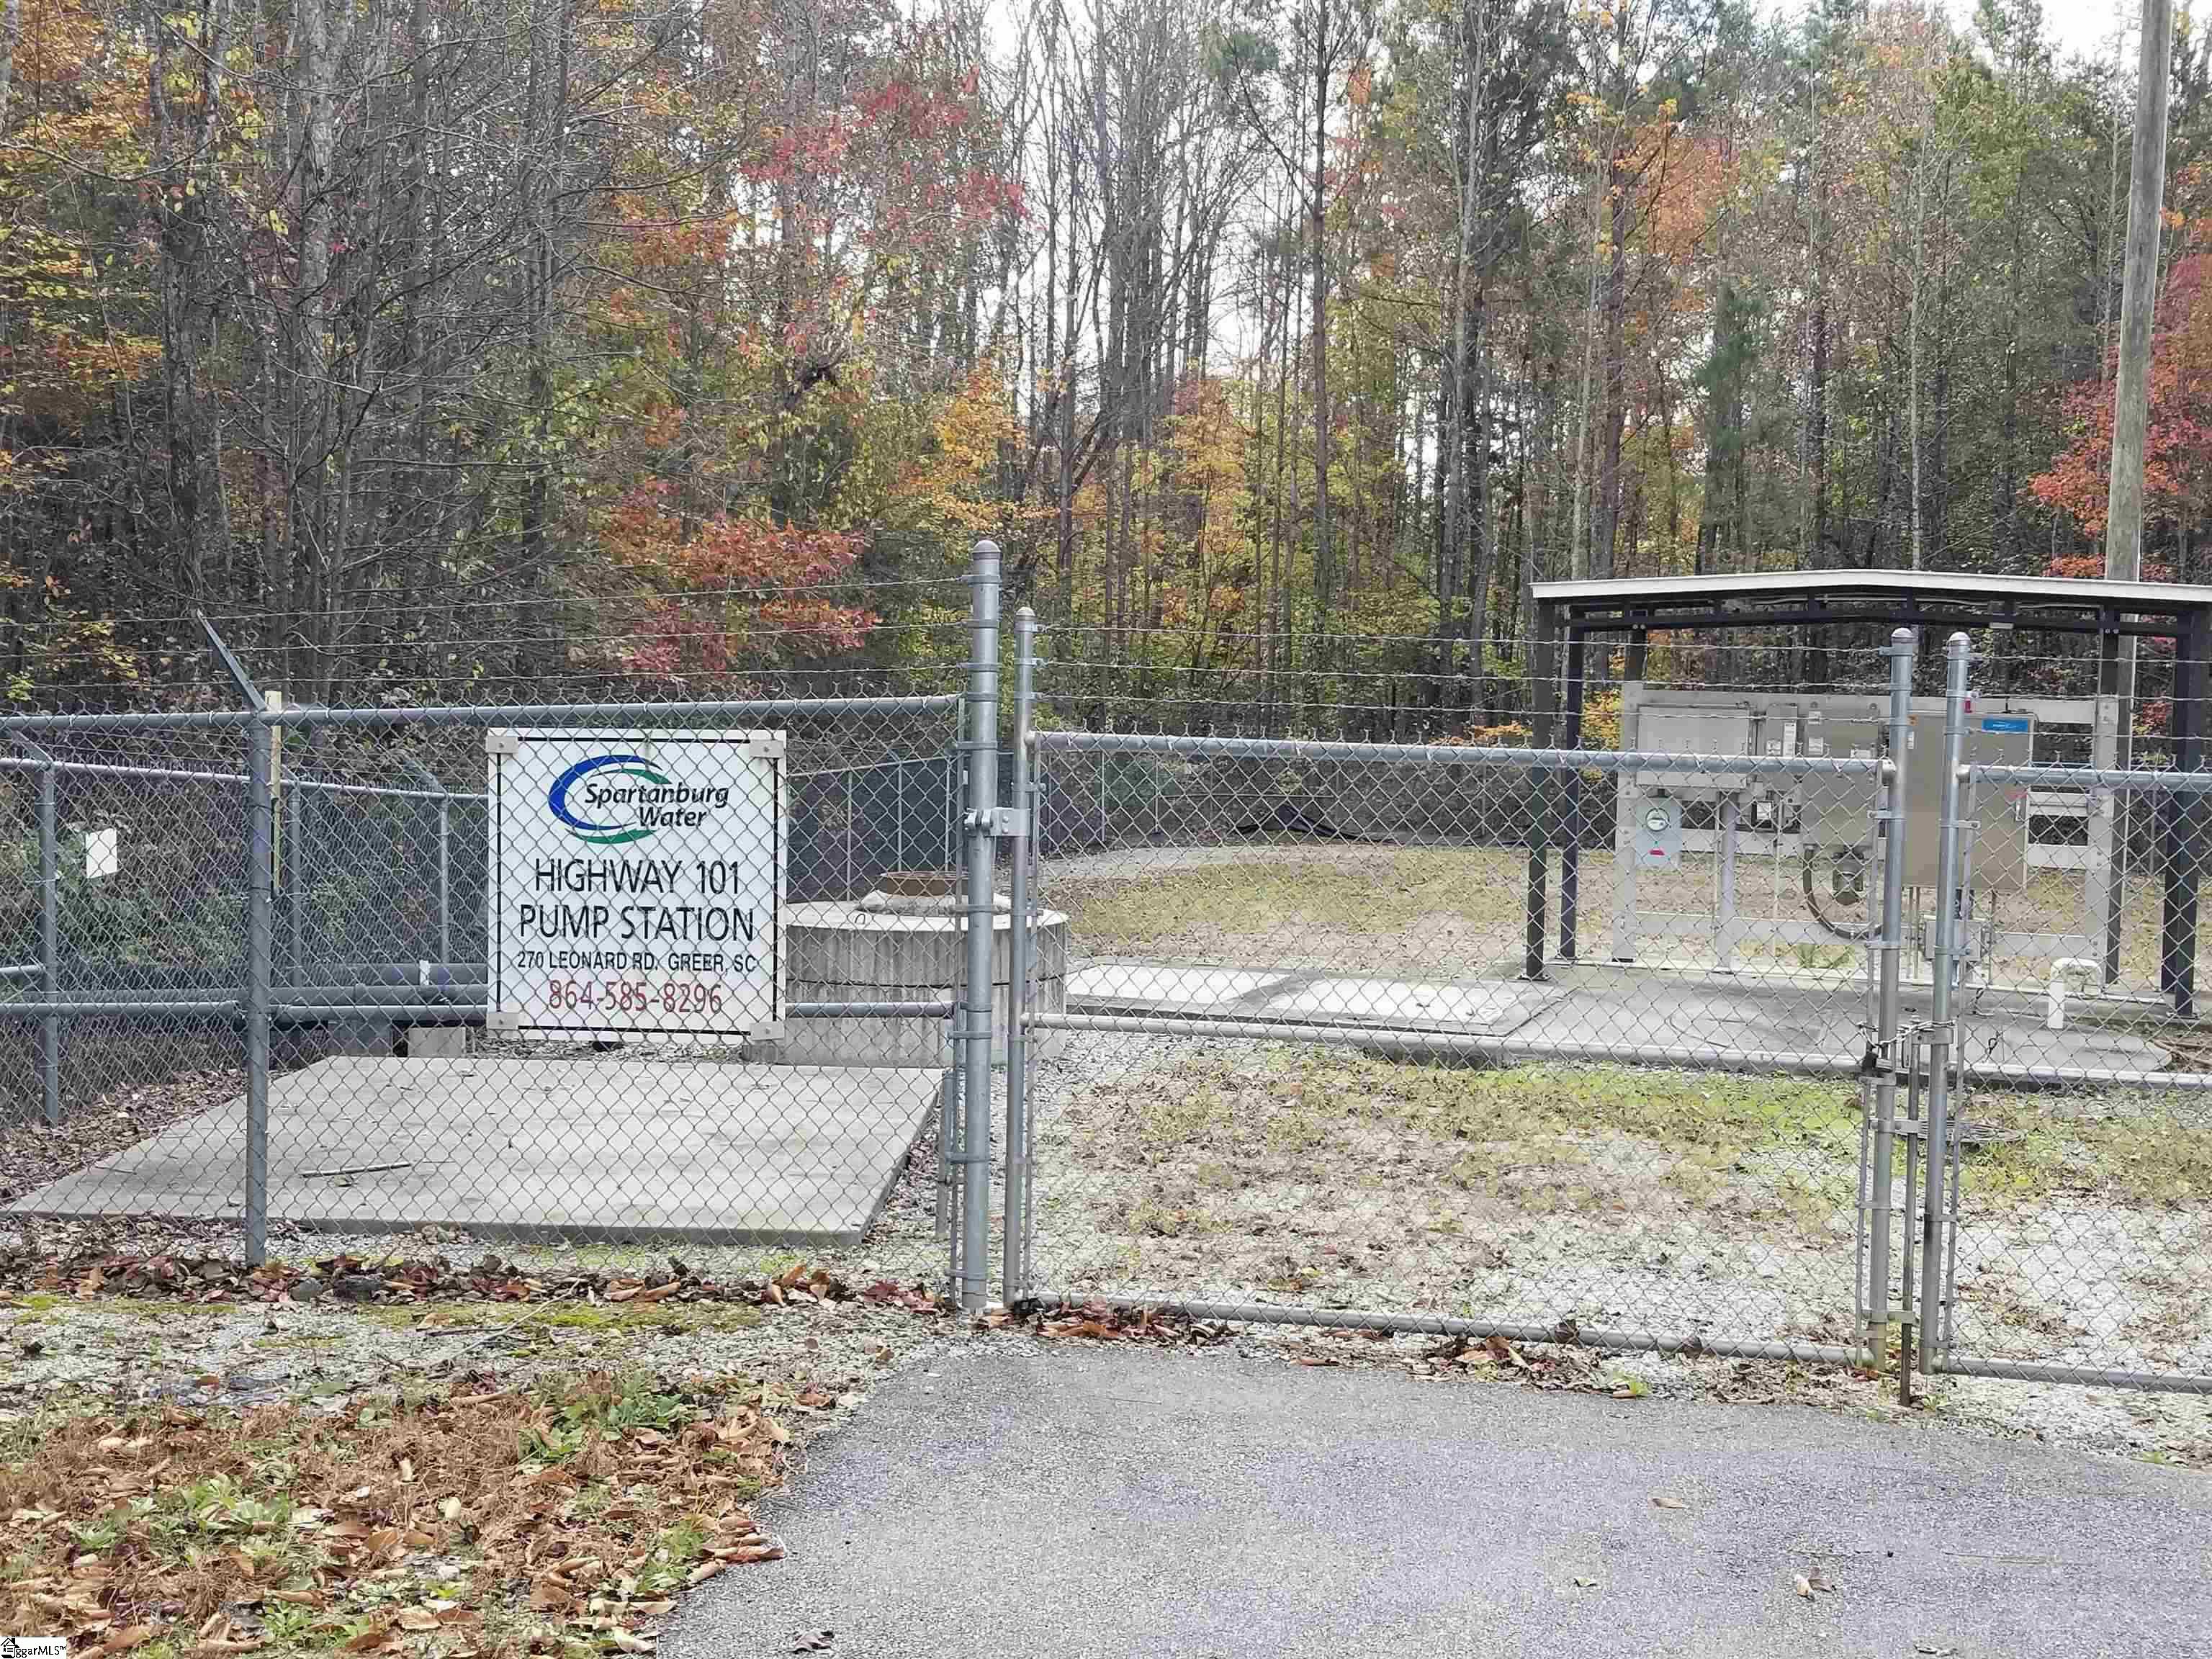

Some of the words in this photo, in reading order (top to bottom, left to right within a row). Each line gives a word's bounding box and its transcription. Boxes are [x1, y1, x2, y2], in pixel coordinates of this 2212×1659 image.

[585, 782, 729, 809] Spartanburg
[638, 806, 707, 827] Water
[535, 859, 682, 894] HIGHWAY
[696, 860, 739, 894] 101
[520, 904, 609, 938] PUMP
[621, 907, 754, 941] STATION
[518, 951, 544, 968] 270
[549, 951, 628, 969] LEONARD
[733, 955, 756, 972] SC
[548, 979, 721, 1014] 864-585-8296
